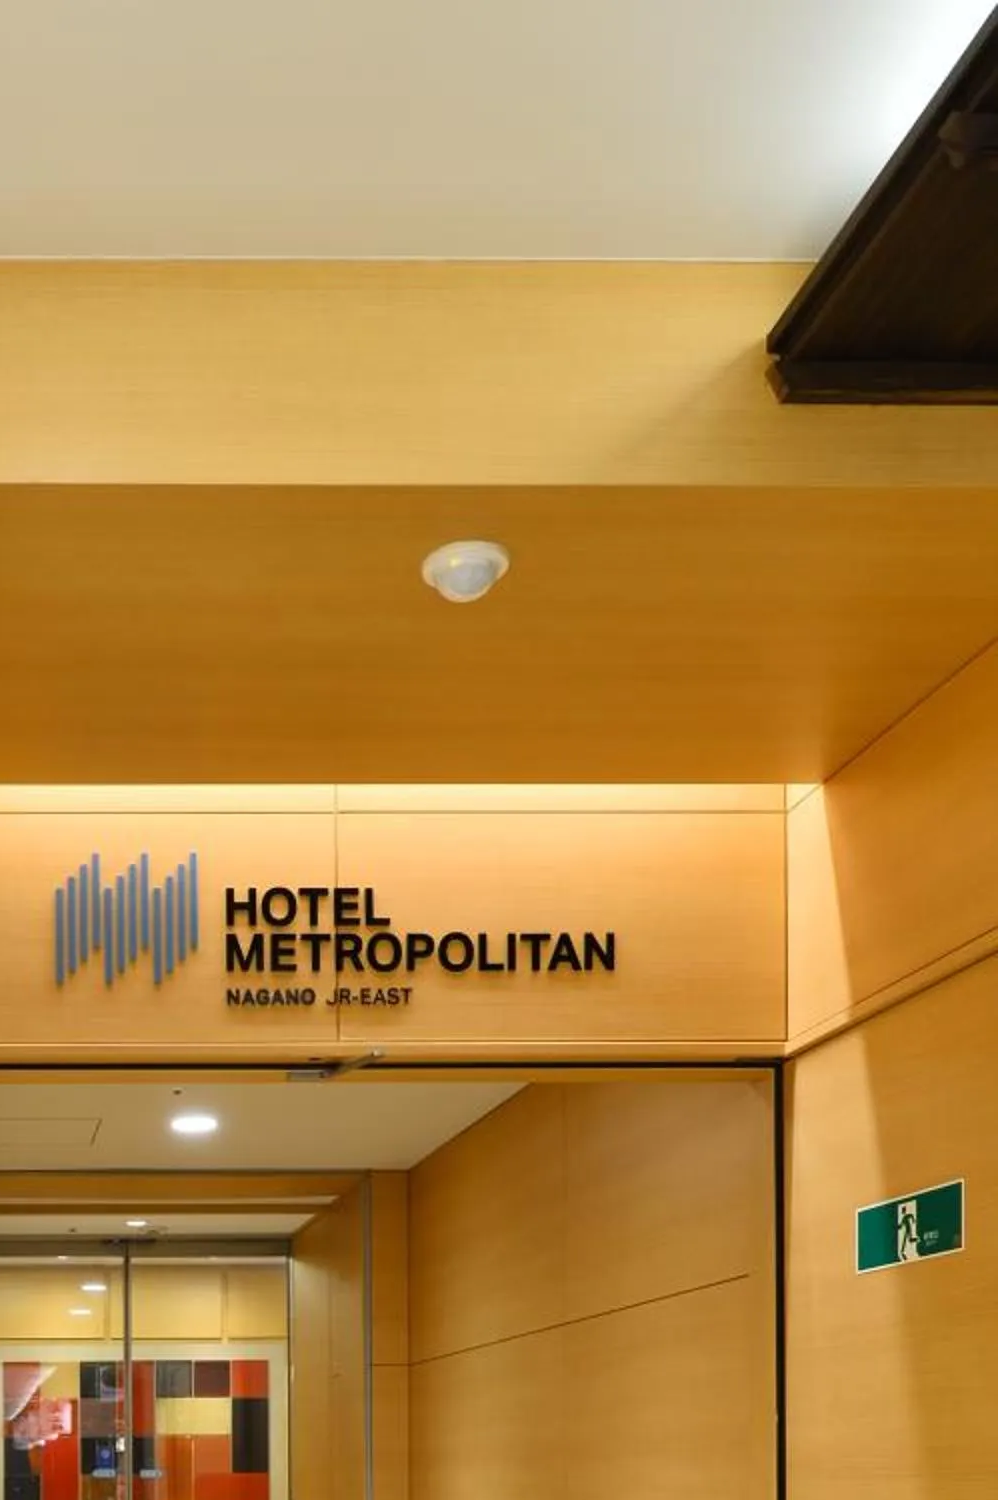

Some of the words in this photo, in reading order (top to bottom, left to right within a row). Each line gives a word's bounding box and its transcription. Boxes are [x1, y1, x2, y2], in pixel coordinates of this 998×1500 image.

[225, 887, 391, 927] HOTEL
[225, 932, 616, 973] METROPOLITAN
[226, 988, 316, 1006] NAGANO
[325, 987, 413, 1007] JR-EAST
